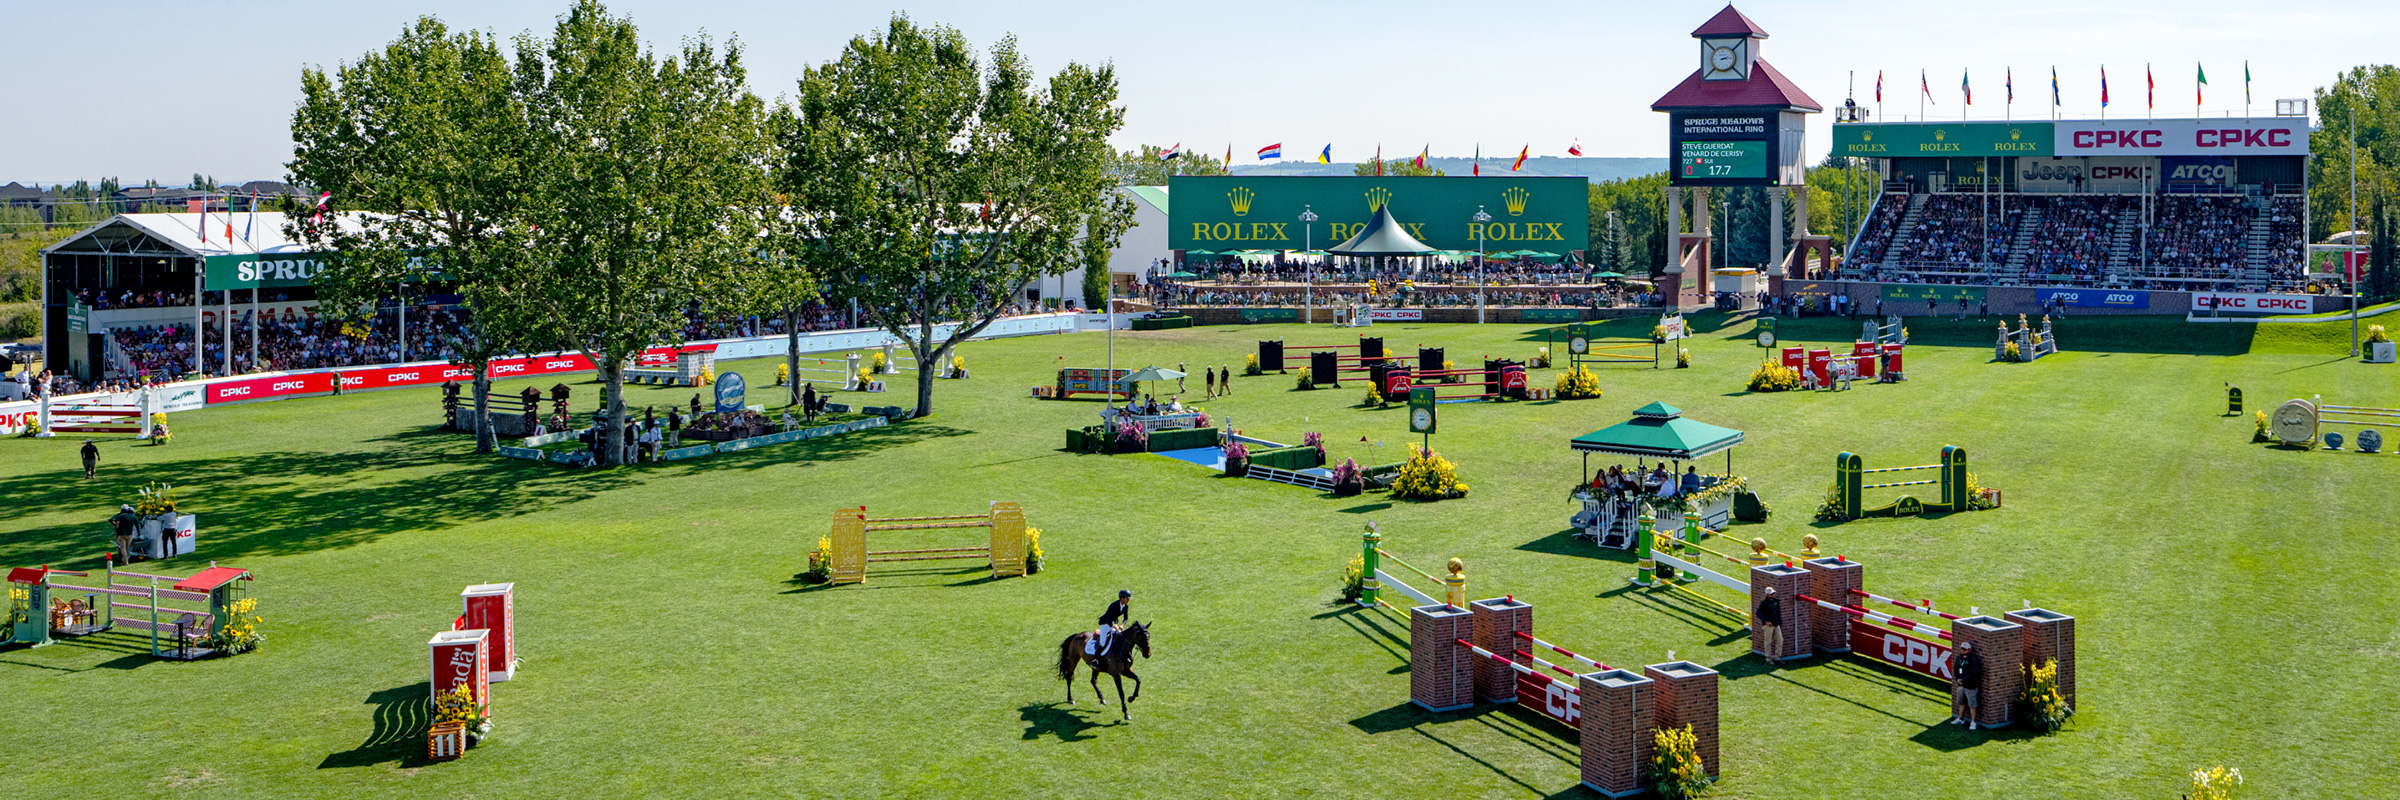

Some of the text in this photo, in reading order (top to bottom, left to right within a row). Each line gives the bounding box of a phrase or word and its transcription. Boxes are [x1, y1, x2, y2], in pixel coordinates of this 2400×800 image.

[1684, 117, 1765, 126] SPRUCE MEADOWS
[1745, 125, 1764, 133] RING
[2073, 128, 2291, 148] CPKC CPKC
[1848, 142, 2036, 152] ROLEX ROLEX ROLEX
[1685, 165, 1731, 176] 0 17.7
[2022, 161, 2082, 182] Jeep
[2170, 164, 2226, 179] ATCO
[1192, 222, 1563, 241] ROLEX ROX ROLEX
[238, 258, 331, 282] SPRU
[2050, 292, 2134, 302] ATCO ATCO
[2197, 296, 2307, 309] CKC CPKC
[495, 363, 525, 373] CPKC
[546, 360, 574, 369] CPKC
[388, 372, 419, 382] CPKC
[273, 380, 304, 391] CPKC
[220, 386, 251, 397] CPKC
[1899, 506, 1920, 514] ROLEX
[176, 529, 192, 539] KC
[1882, 633, 1954, 680] CPK
[1545, 682, 1580, 723] CP
[435, 733, 456, 757] 11
